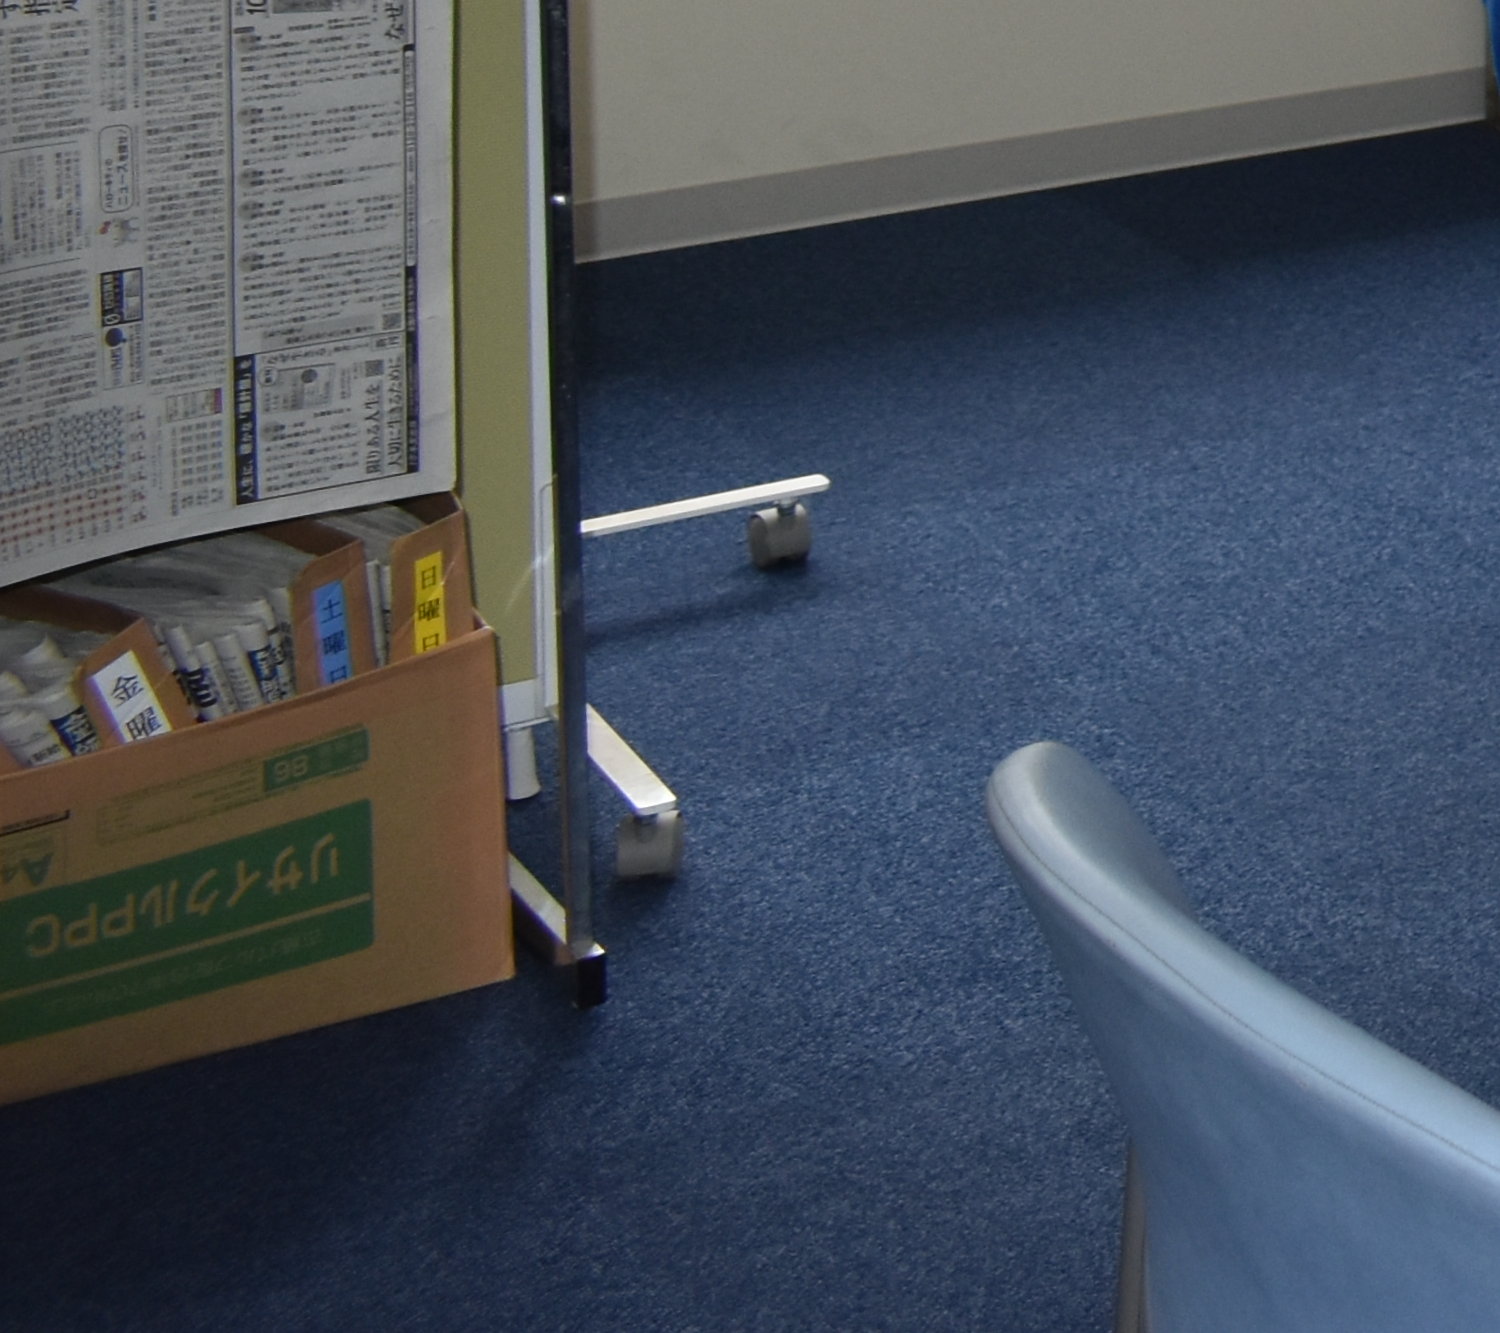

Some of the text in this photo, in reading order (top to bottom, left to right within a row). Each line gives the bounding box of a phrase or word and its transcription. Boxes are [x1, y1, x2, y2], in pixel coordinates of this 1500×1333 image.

[26, 832, 340, 959] リサイクルPPC
